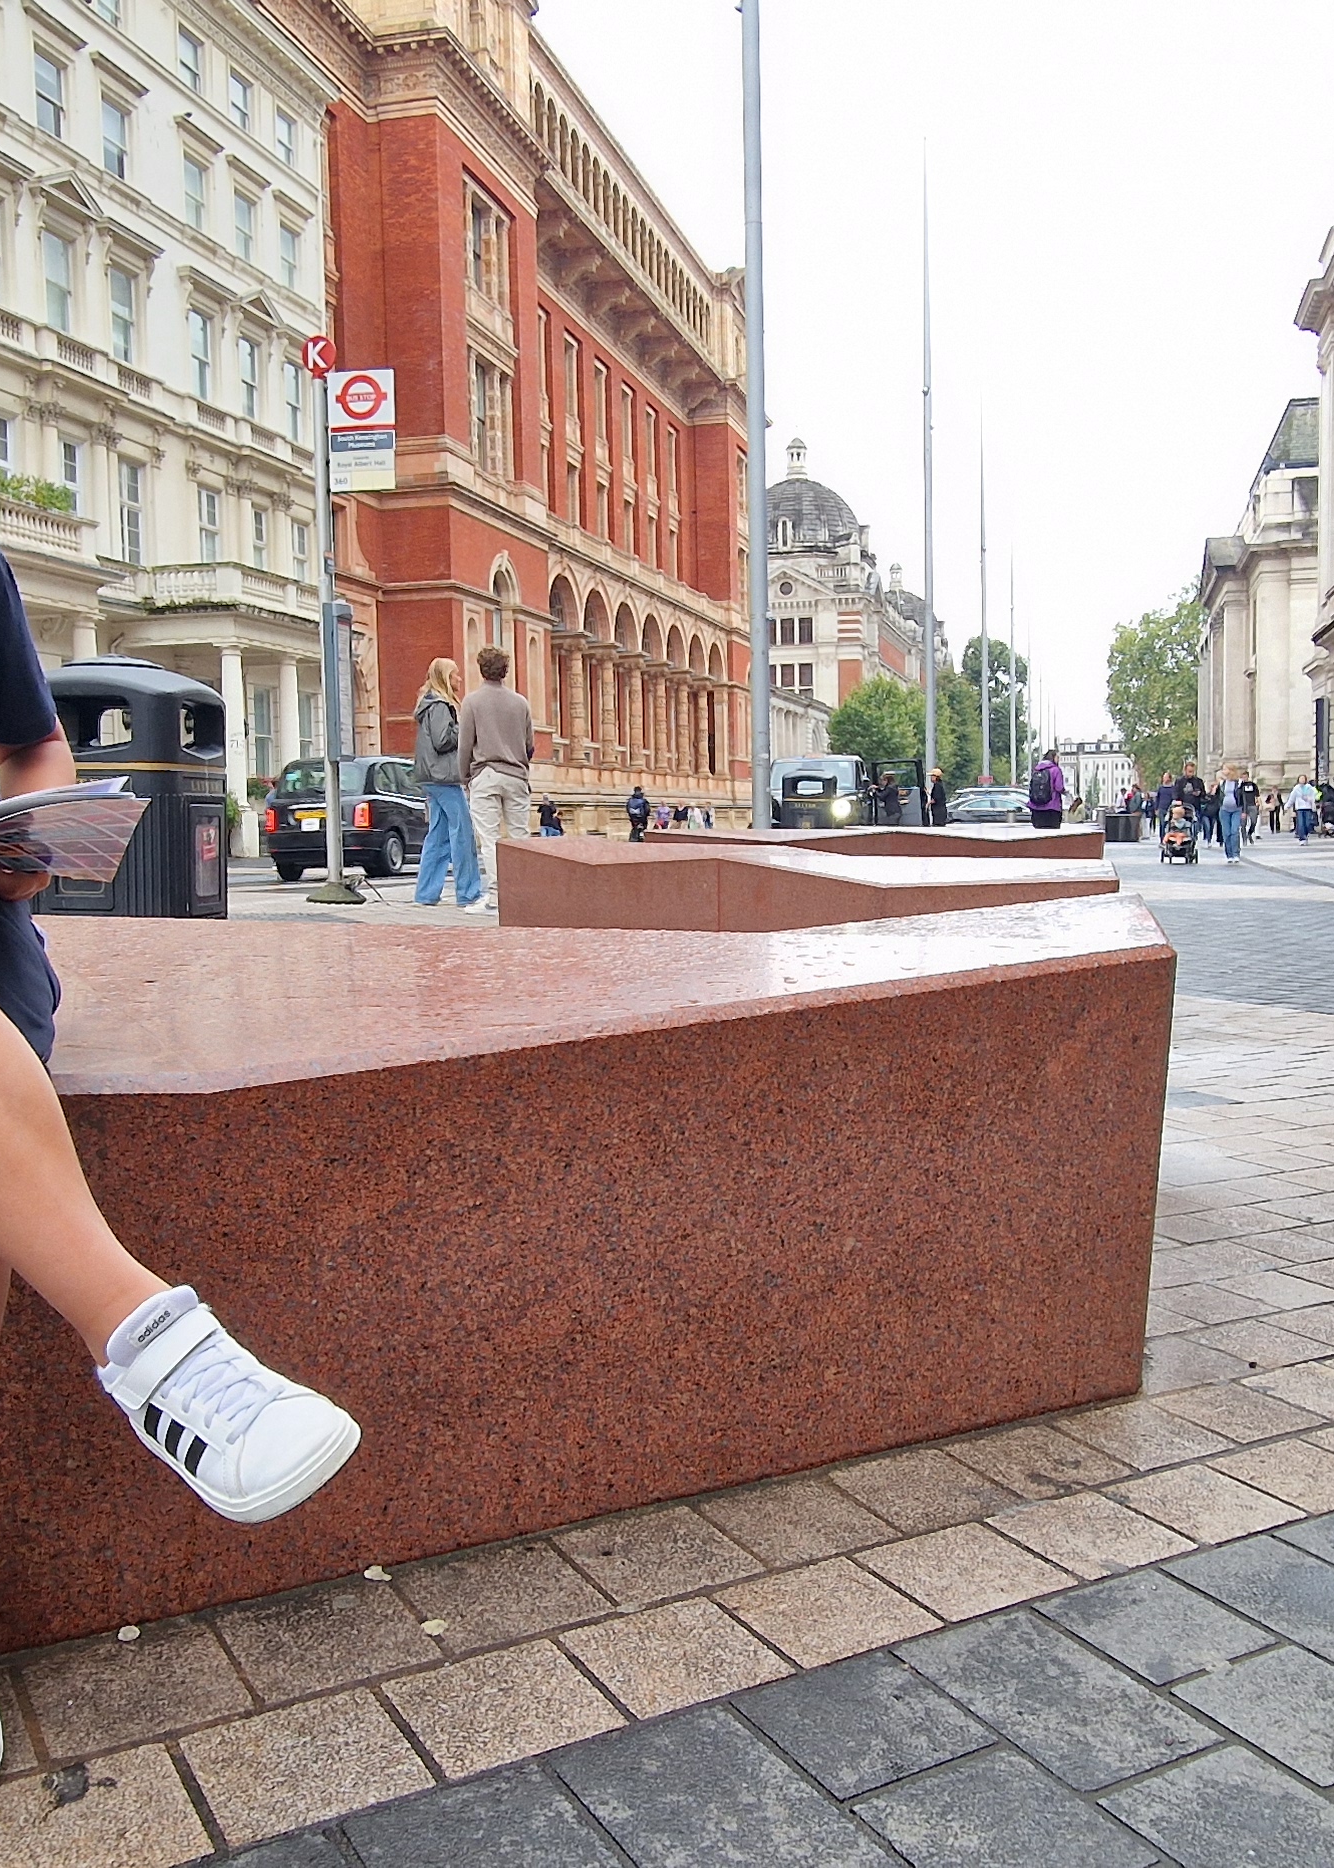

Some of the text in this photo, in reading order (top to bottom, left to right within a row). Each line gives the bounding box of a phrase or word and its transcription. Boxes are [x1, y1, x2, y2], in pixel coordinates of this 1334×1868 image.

[307, 341, 328, 369] K
[334, 477, 349, 486] 360
[137, 1308, 171, 1344] adidas
